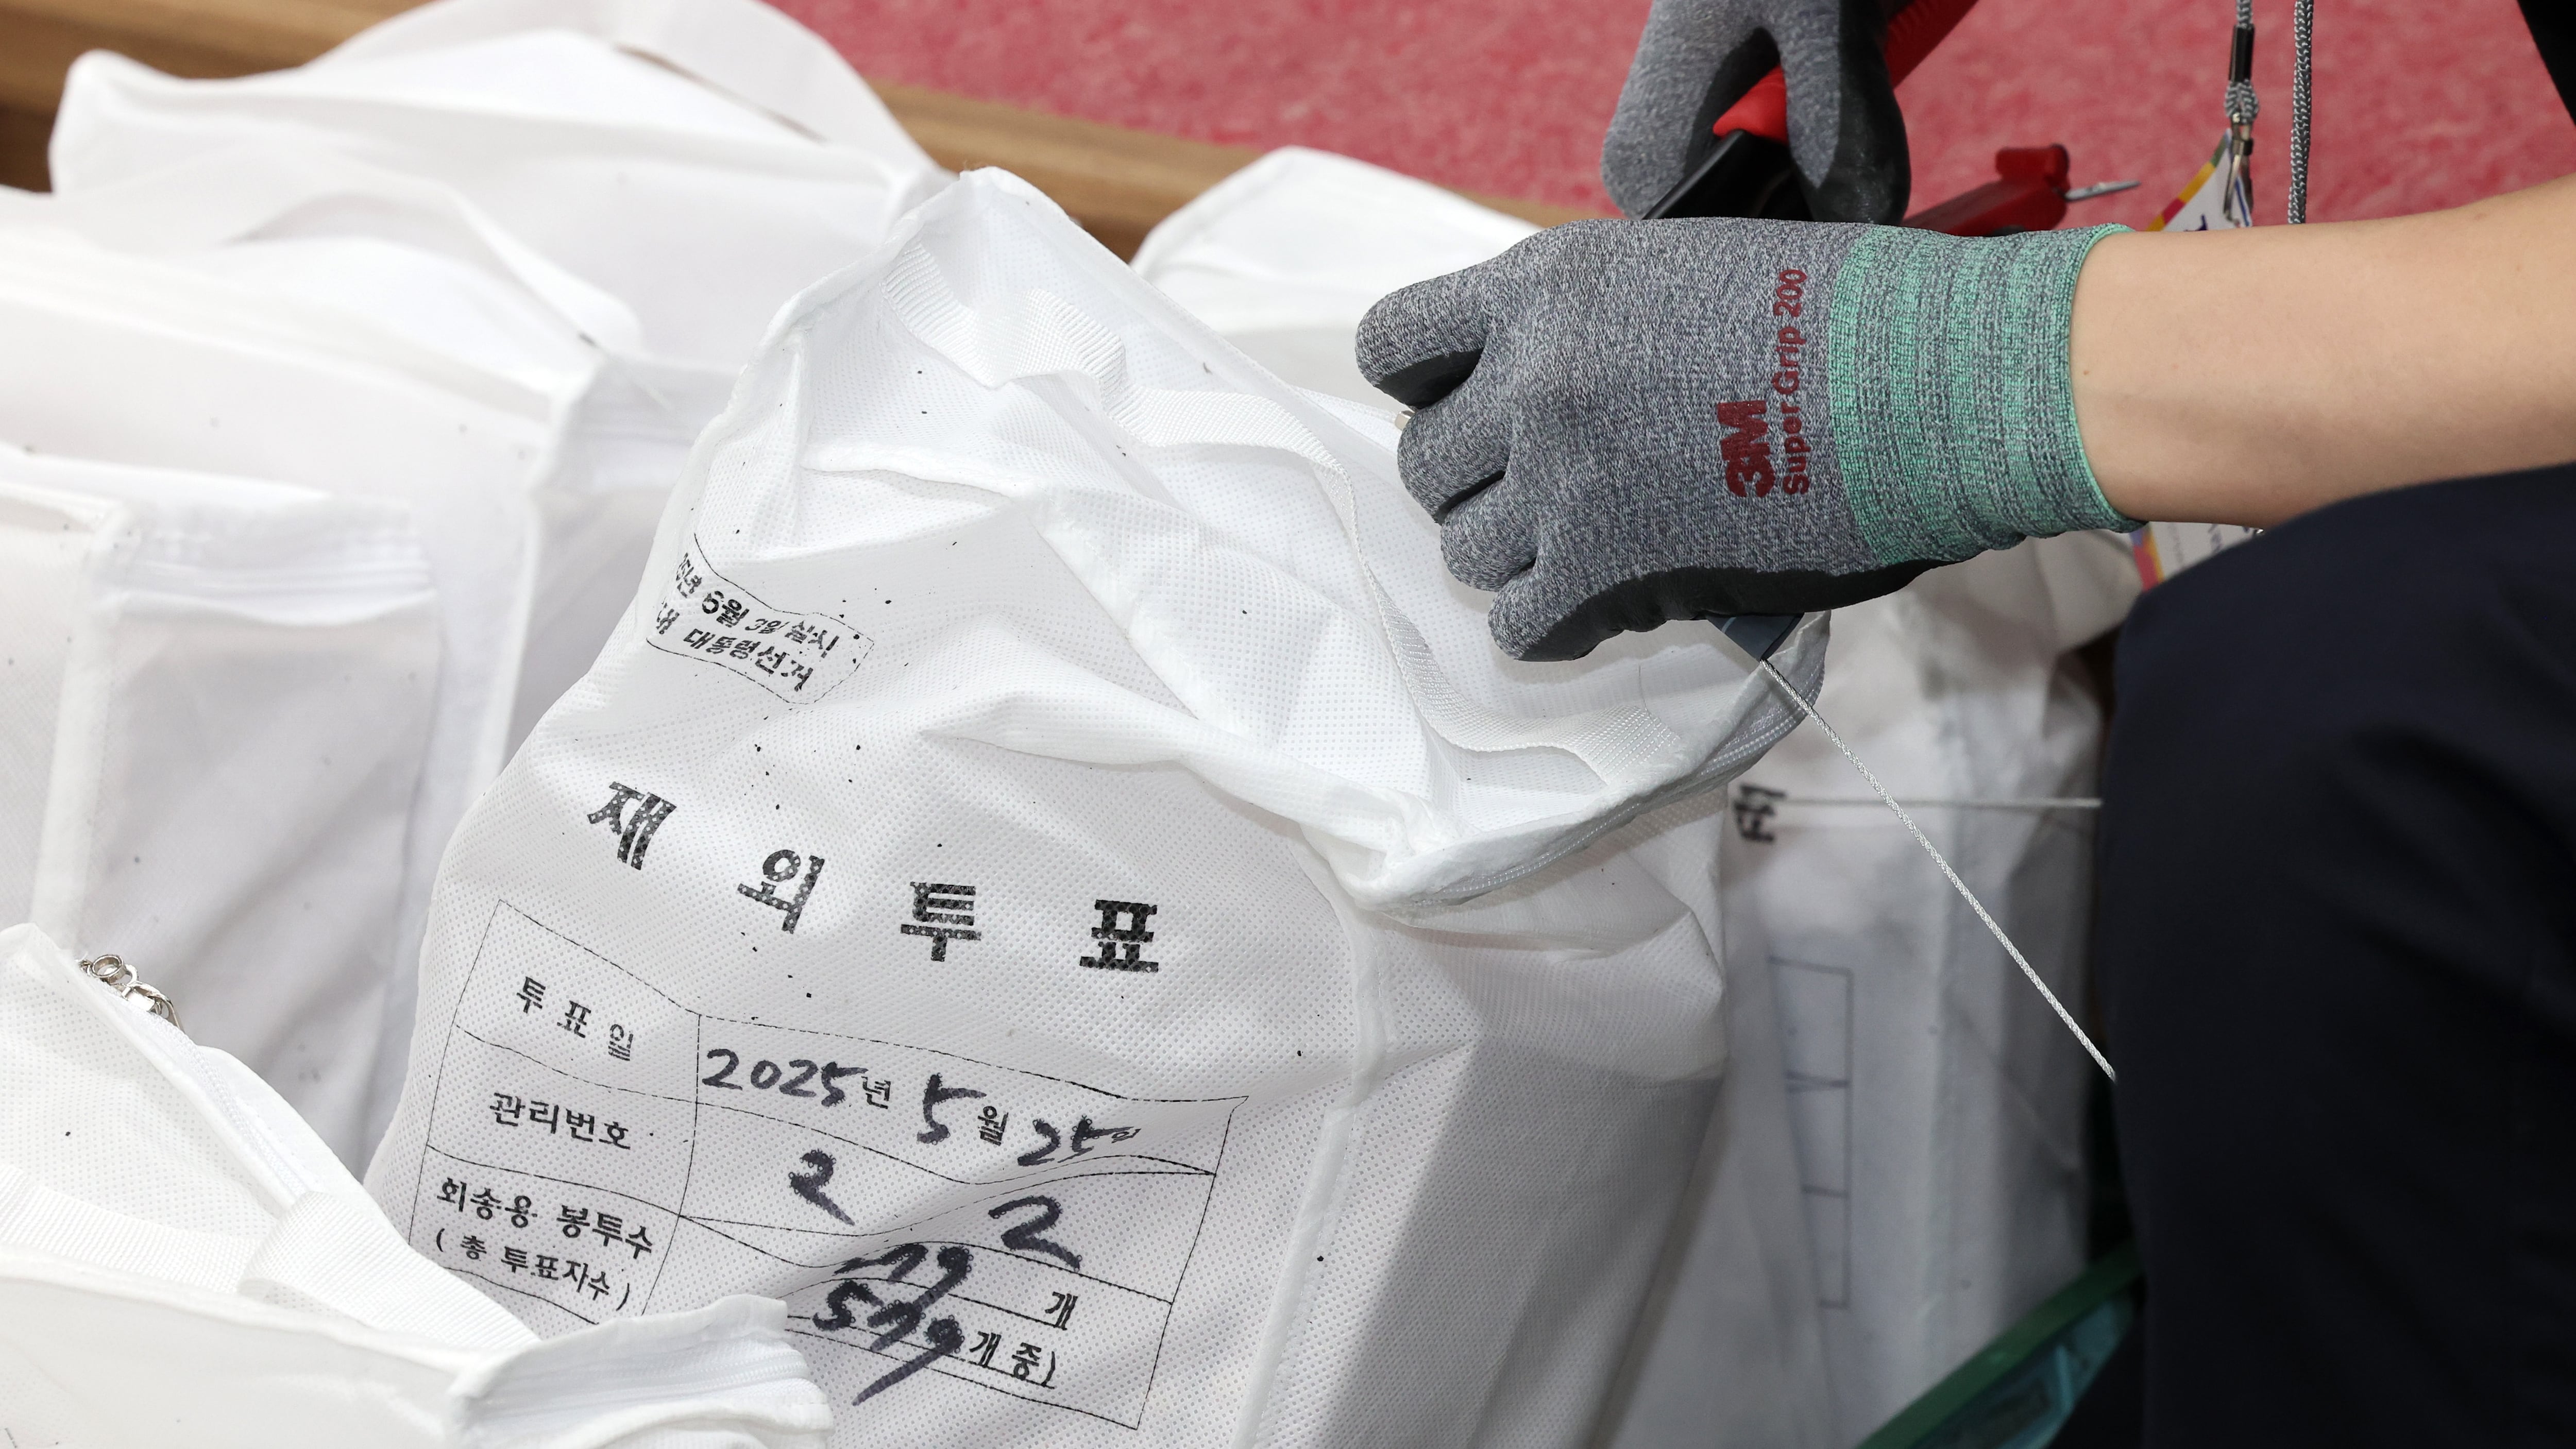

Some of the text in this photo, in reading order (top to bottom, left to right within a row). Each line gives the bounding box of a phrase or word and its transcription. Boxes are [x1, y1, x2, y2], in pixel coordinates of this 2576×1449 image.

[1771, 268, 1811, 496] Super Grip 200
[1717, 400, 1776, 498] 3M
[683, 628, 814, 692] 대통령선거
[702, 590, 750, 628] 6월
[744, 618, 791, 634] 3일
[784, 620, 840, 659] 실시
[489, 1092, 631, 1150] 관리번호
[436, 1177, 653, 1259] 회송용 봉투수
[787, 1148, 1083, 1271] 2 2
